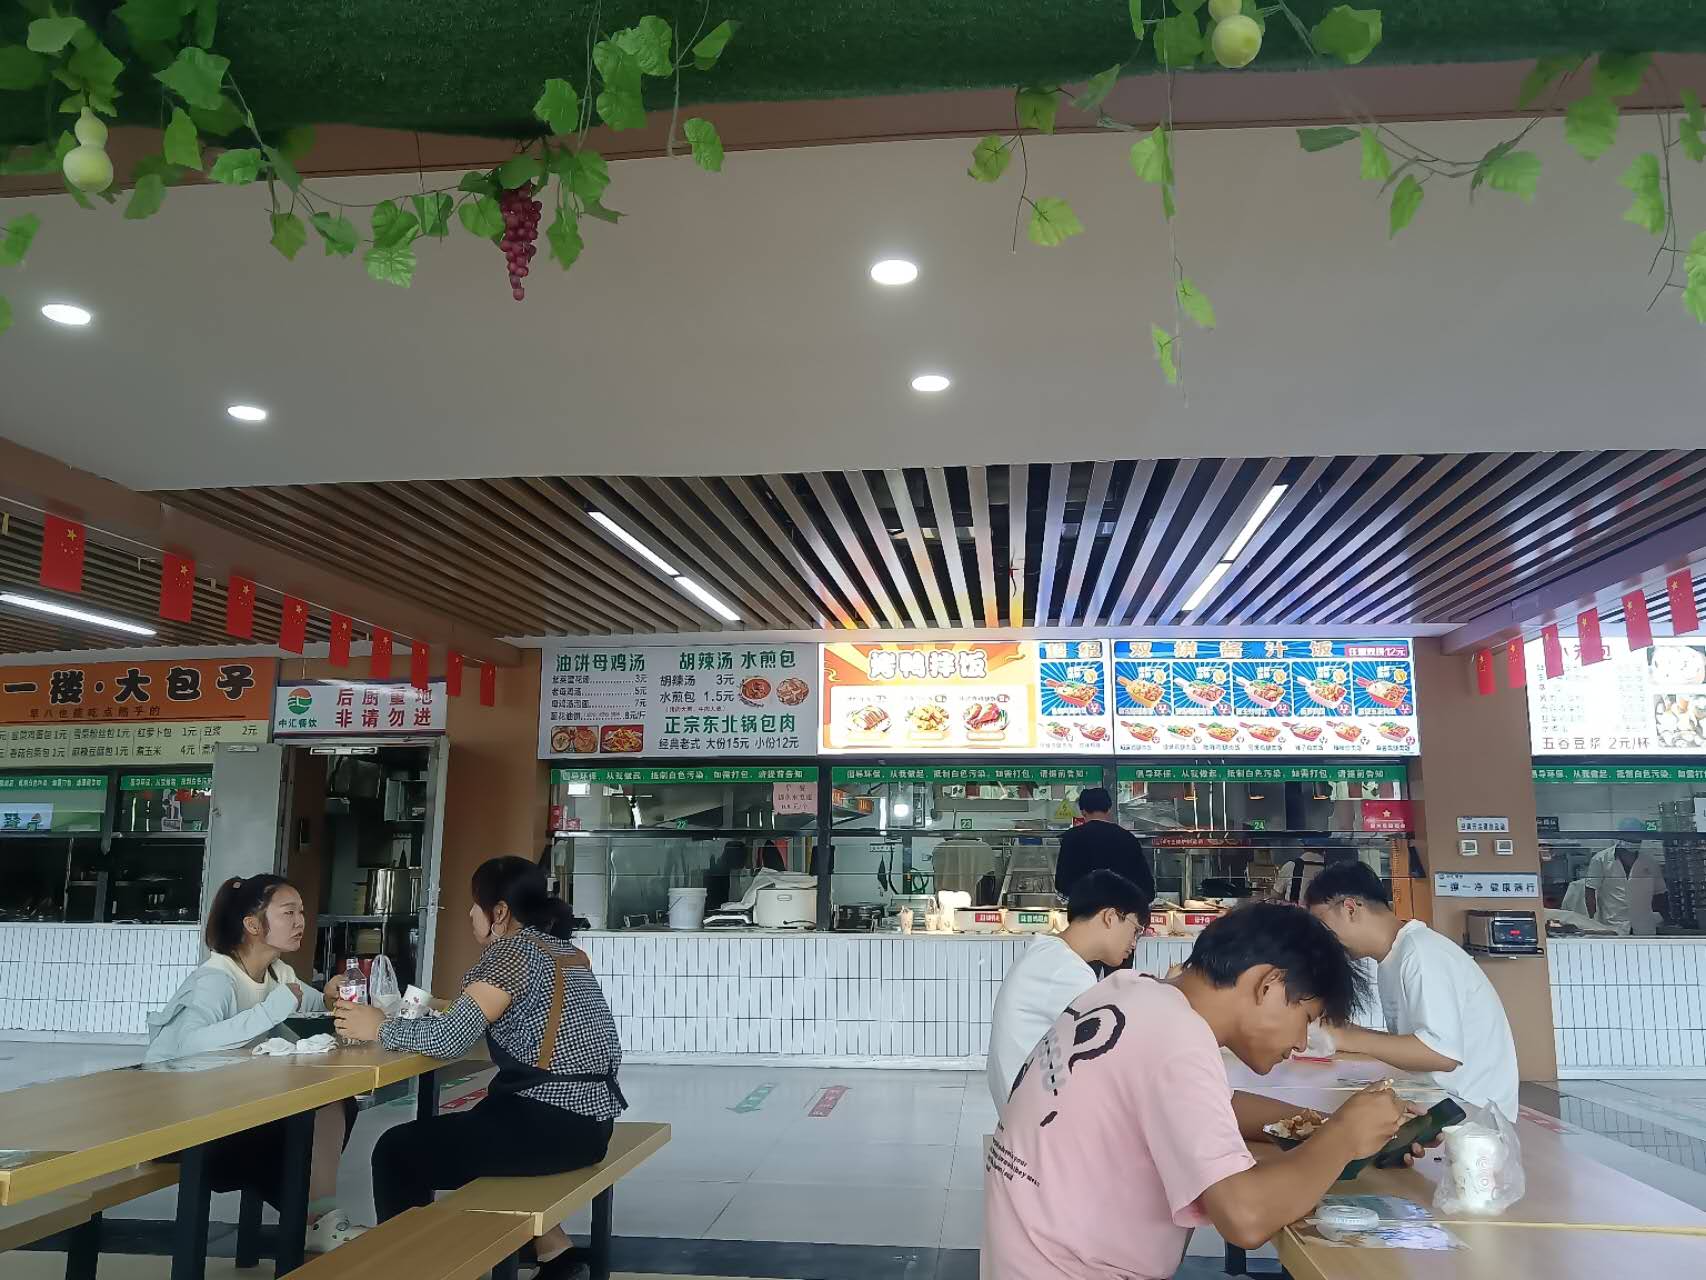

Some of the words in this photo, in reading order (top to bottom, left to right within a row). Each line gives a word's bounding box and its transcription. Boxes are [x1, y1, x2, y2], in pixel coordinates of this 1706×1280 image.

[556, 653, 645, 672] 油饼母鸡汤
[679, 651, 733, 670] 胡辣汤
[740, 650, 796, 669] 水煎包
[634, 674, 647, 684] 3元
[660, 674, 695, 687] 胡辣汤
[716, 674, 734, 686] 3元
[336, 687, 433, 706] 后厨重地
[634, 686, 647, 695] 5元
[660, 691, 695, 703] 水煎包
[704, 691, 734, 702] 1.5元
[278, 718, 317, 728] 中汇餐饮
[335, 708, 432, 728] 非请勿进
[664, 714, 795, 734] 正宗东北锅包肉
[137, 728, 172, 738] 红萝卜包
[182, 727, 198, 737] 1元
[203, 726, 222, 736] 豆浆
[242, 725, 258, 736] 2元
[658, 738, 701, 750] 经典老式
[705, 737, 749, 749] 大份15元
[755, 737, 799, 749] 小份12元
[1543, 737, 1600, 750] 五谷豆浆
[1609, 737, 1650, 750] 2元/杯
[180, 745, 195, 755] 4元
[962, 820, 971, 828] 23
[1254, 821, 1264, 830] 24
